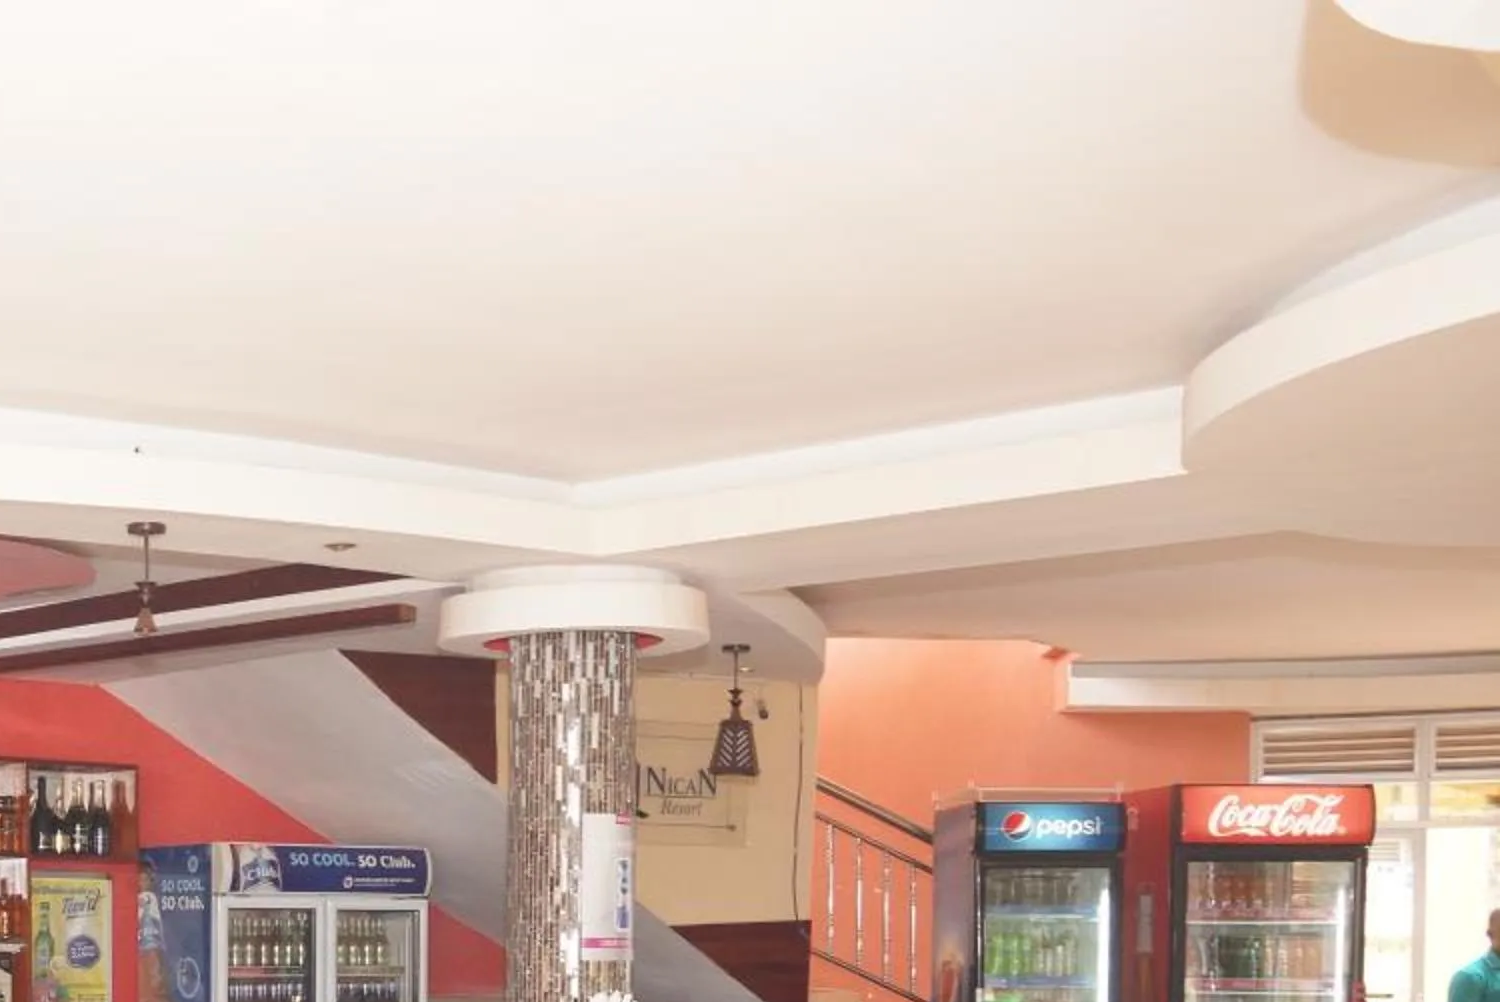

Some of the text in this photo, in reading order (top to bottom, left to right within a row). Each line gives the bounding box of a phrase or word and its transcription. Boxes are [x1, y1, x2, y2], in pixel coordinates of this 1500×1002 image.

[1208, 794, 1344, 837] Coca-Cola
[1036, 816, 1101, 839] pepsi
[290, 852, 309, 866] SO
[357, 854, 377, 868] SO
[161, 895, 176, 910] SO
